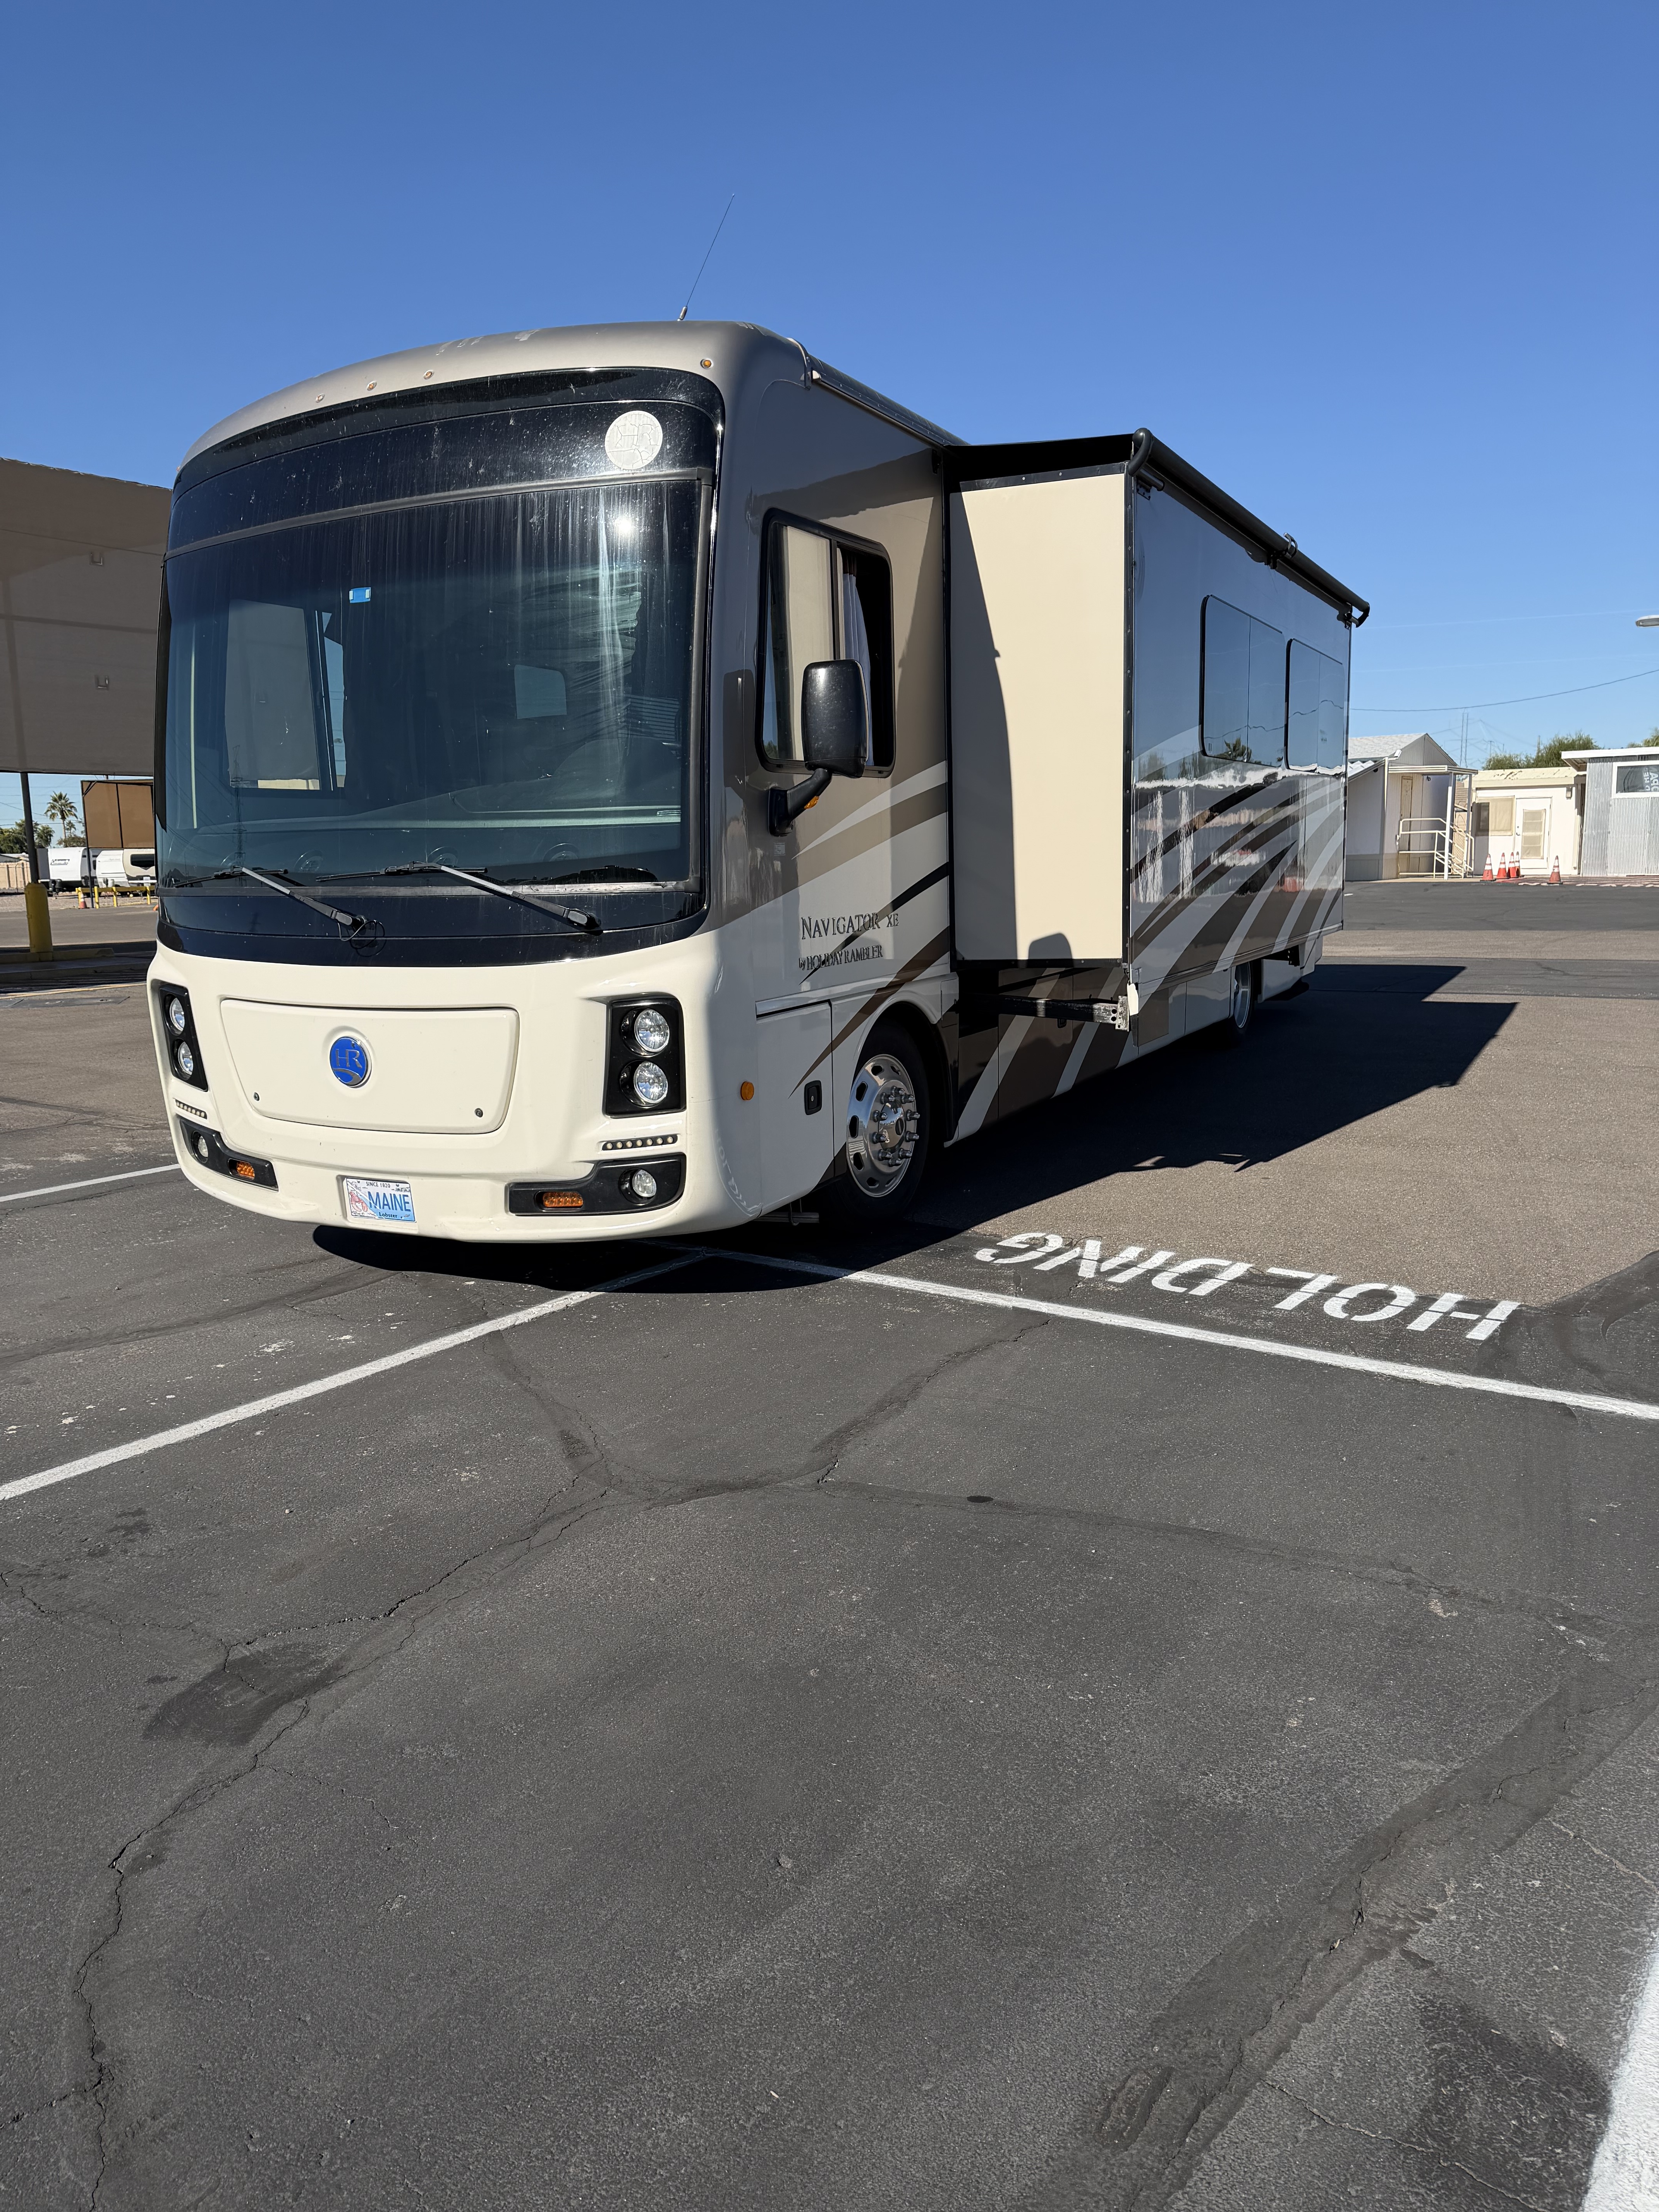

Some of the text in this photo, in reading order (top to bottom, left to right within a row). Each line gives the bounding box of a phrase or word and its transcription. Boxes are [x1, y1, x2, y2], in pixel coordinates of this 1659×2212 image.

[801, 912, 899, 940] NAVIGATOR XE
[799, 945, 883, 970] by HOLIDAY RAMBLER
[336, 1048, 362, 1068] HR
[368, 1191, 411, 1212] MAINE
[974, 1232, 1523, 1341] HOLDING
